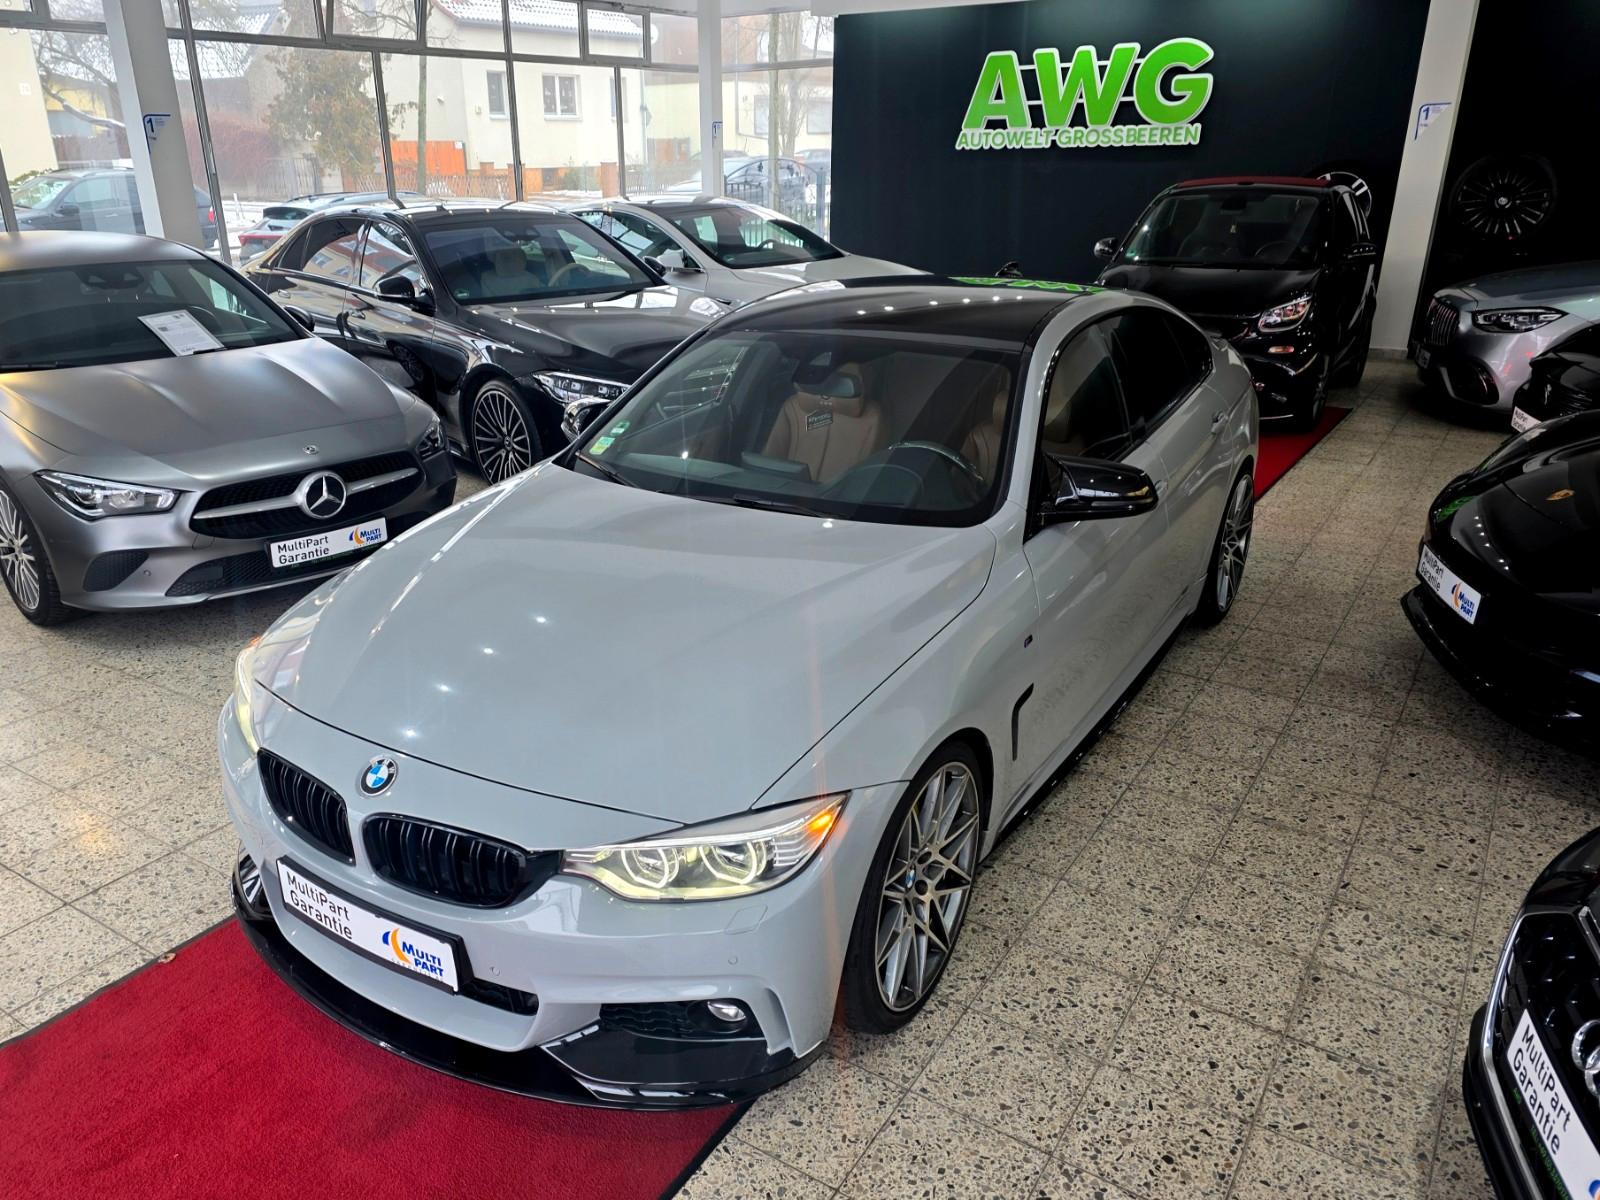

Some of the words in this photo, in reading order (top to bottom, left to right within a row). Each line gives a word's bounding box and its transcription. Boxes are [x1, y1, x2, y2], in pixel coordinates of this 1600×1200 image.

[962, 37, 1215, 129] AWG
[360, 527, 381, 539] MULTI
[366, 533, 382, 543] PART
[277, 535, 329, 554] MultiPart
[279, 546, 330, 565] Garantie
[1461, 604, 1474, 618] PART
[286, 871, 350, 921] MultiPart
[290, 889, 353, 940] Garantie
[402, 941, 441, 966] MULTI
[414, 958, 444, 977] PART
[1521, 1023, 1571, 1132] MultiPart
[1513, 1047, 1560, 1155] Garantie
